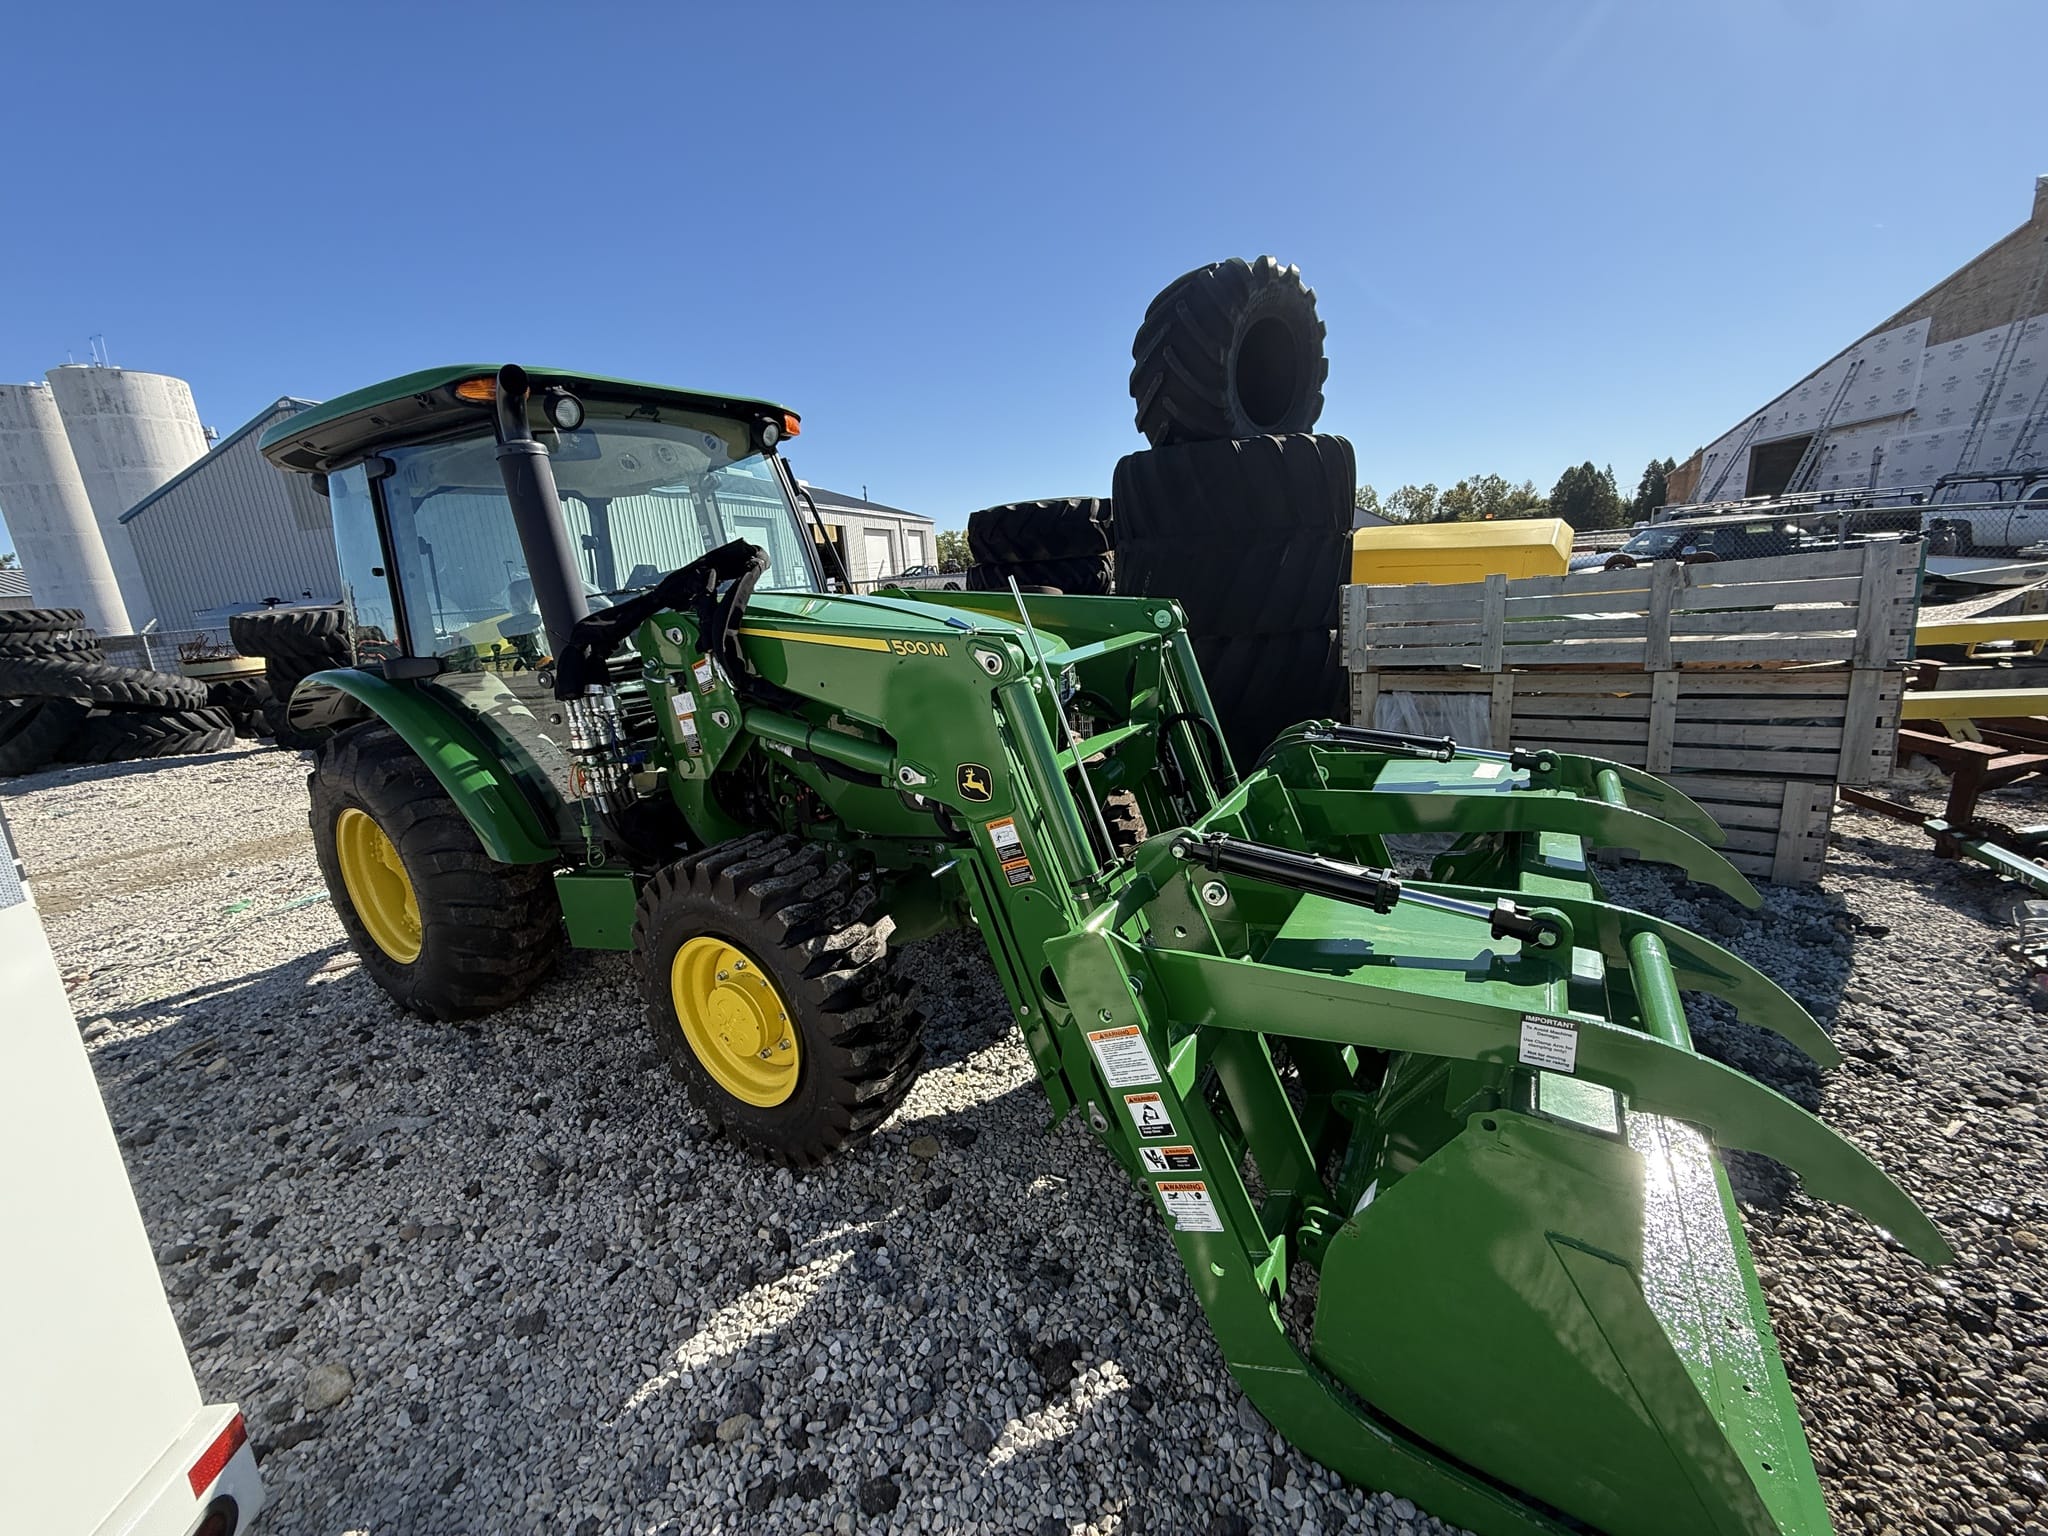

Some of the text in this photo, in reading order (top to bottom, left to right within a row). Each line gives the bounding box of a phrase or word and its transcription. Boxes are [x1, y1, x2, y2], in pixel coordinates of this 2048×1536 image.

[1525, 1015, 1576, 1029] IMPORTANT
[1104, 1030, 1130, 1039] WARNING
[1549, 1029, 1573, 1038] Machine
[1133, 1095, 1158, 1103] WARNING
